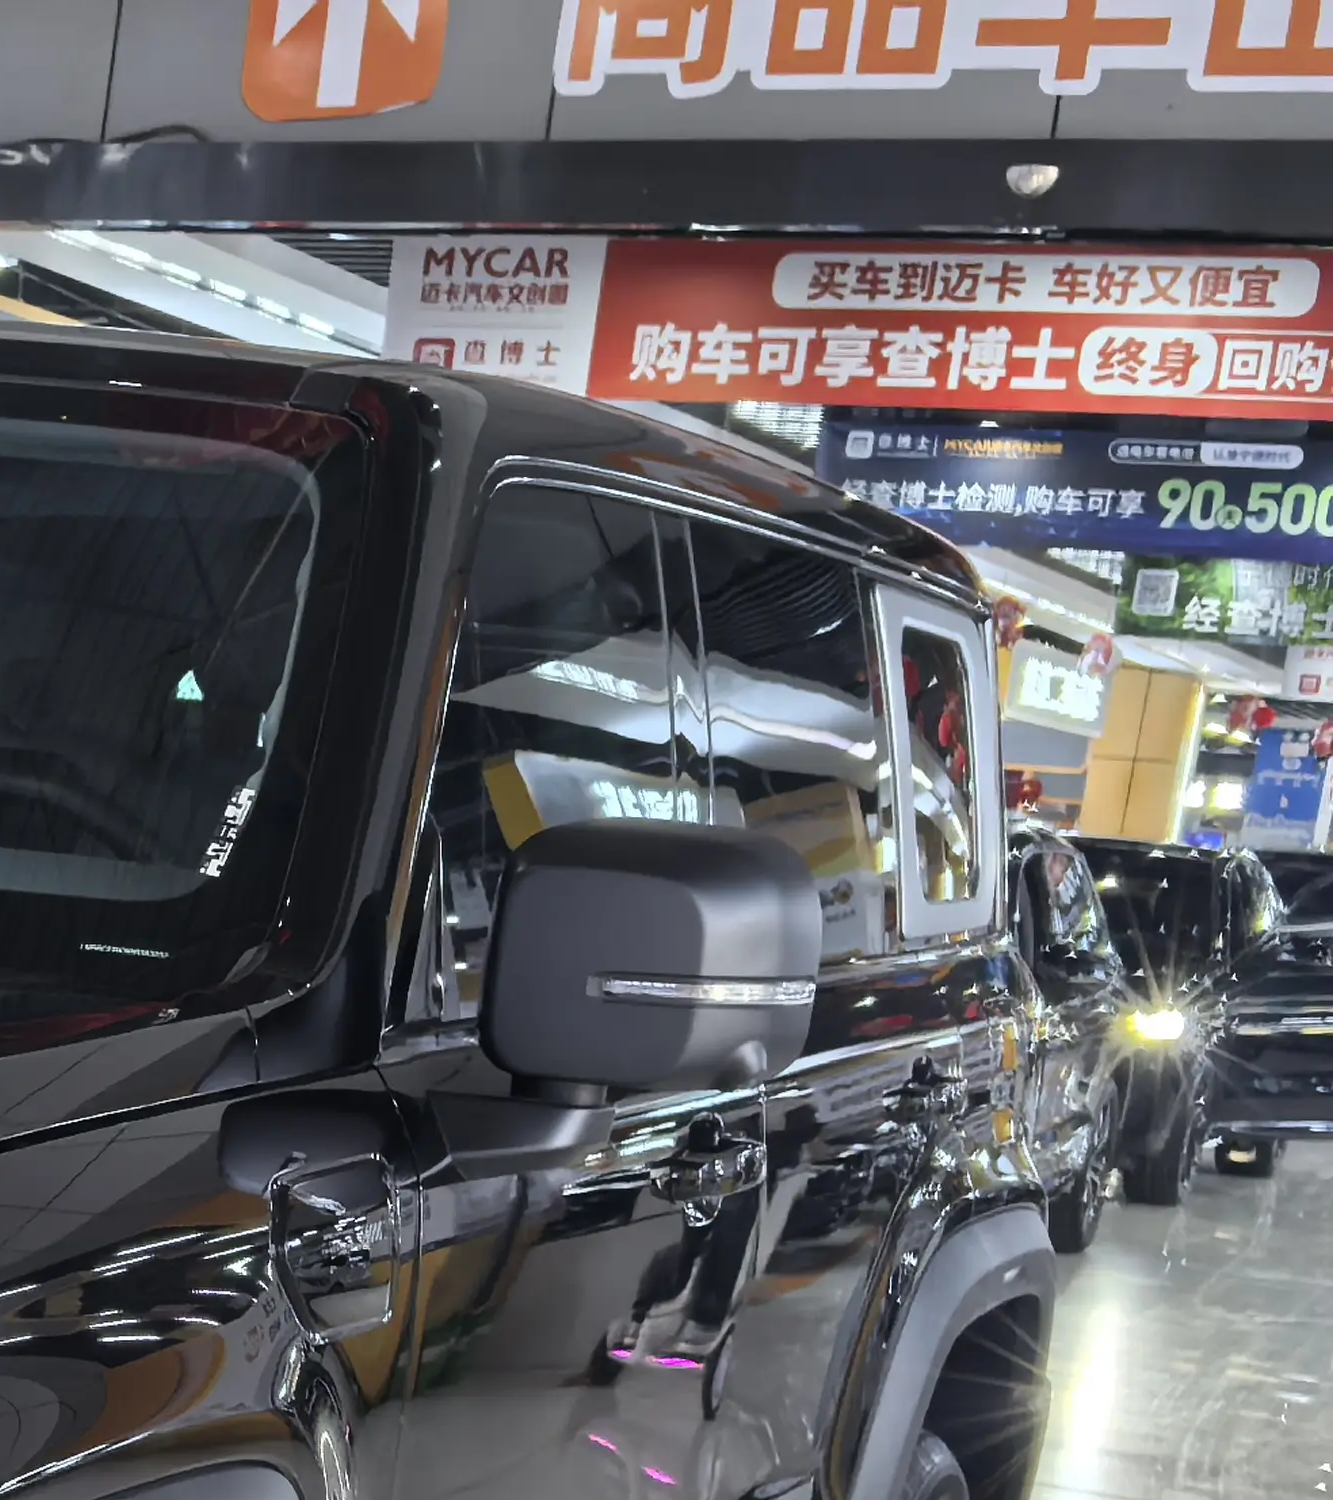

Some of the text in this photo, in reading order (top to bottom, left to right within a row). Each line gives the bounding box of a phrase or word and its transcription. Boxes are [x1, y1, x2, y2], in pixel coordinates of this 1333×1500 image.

[422, 247, 570, 279] MYCAR
[808, 260, 1281, 309] 买车到迈卡 车好又便宜
